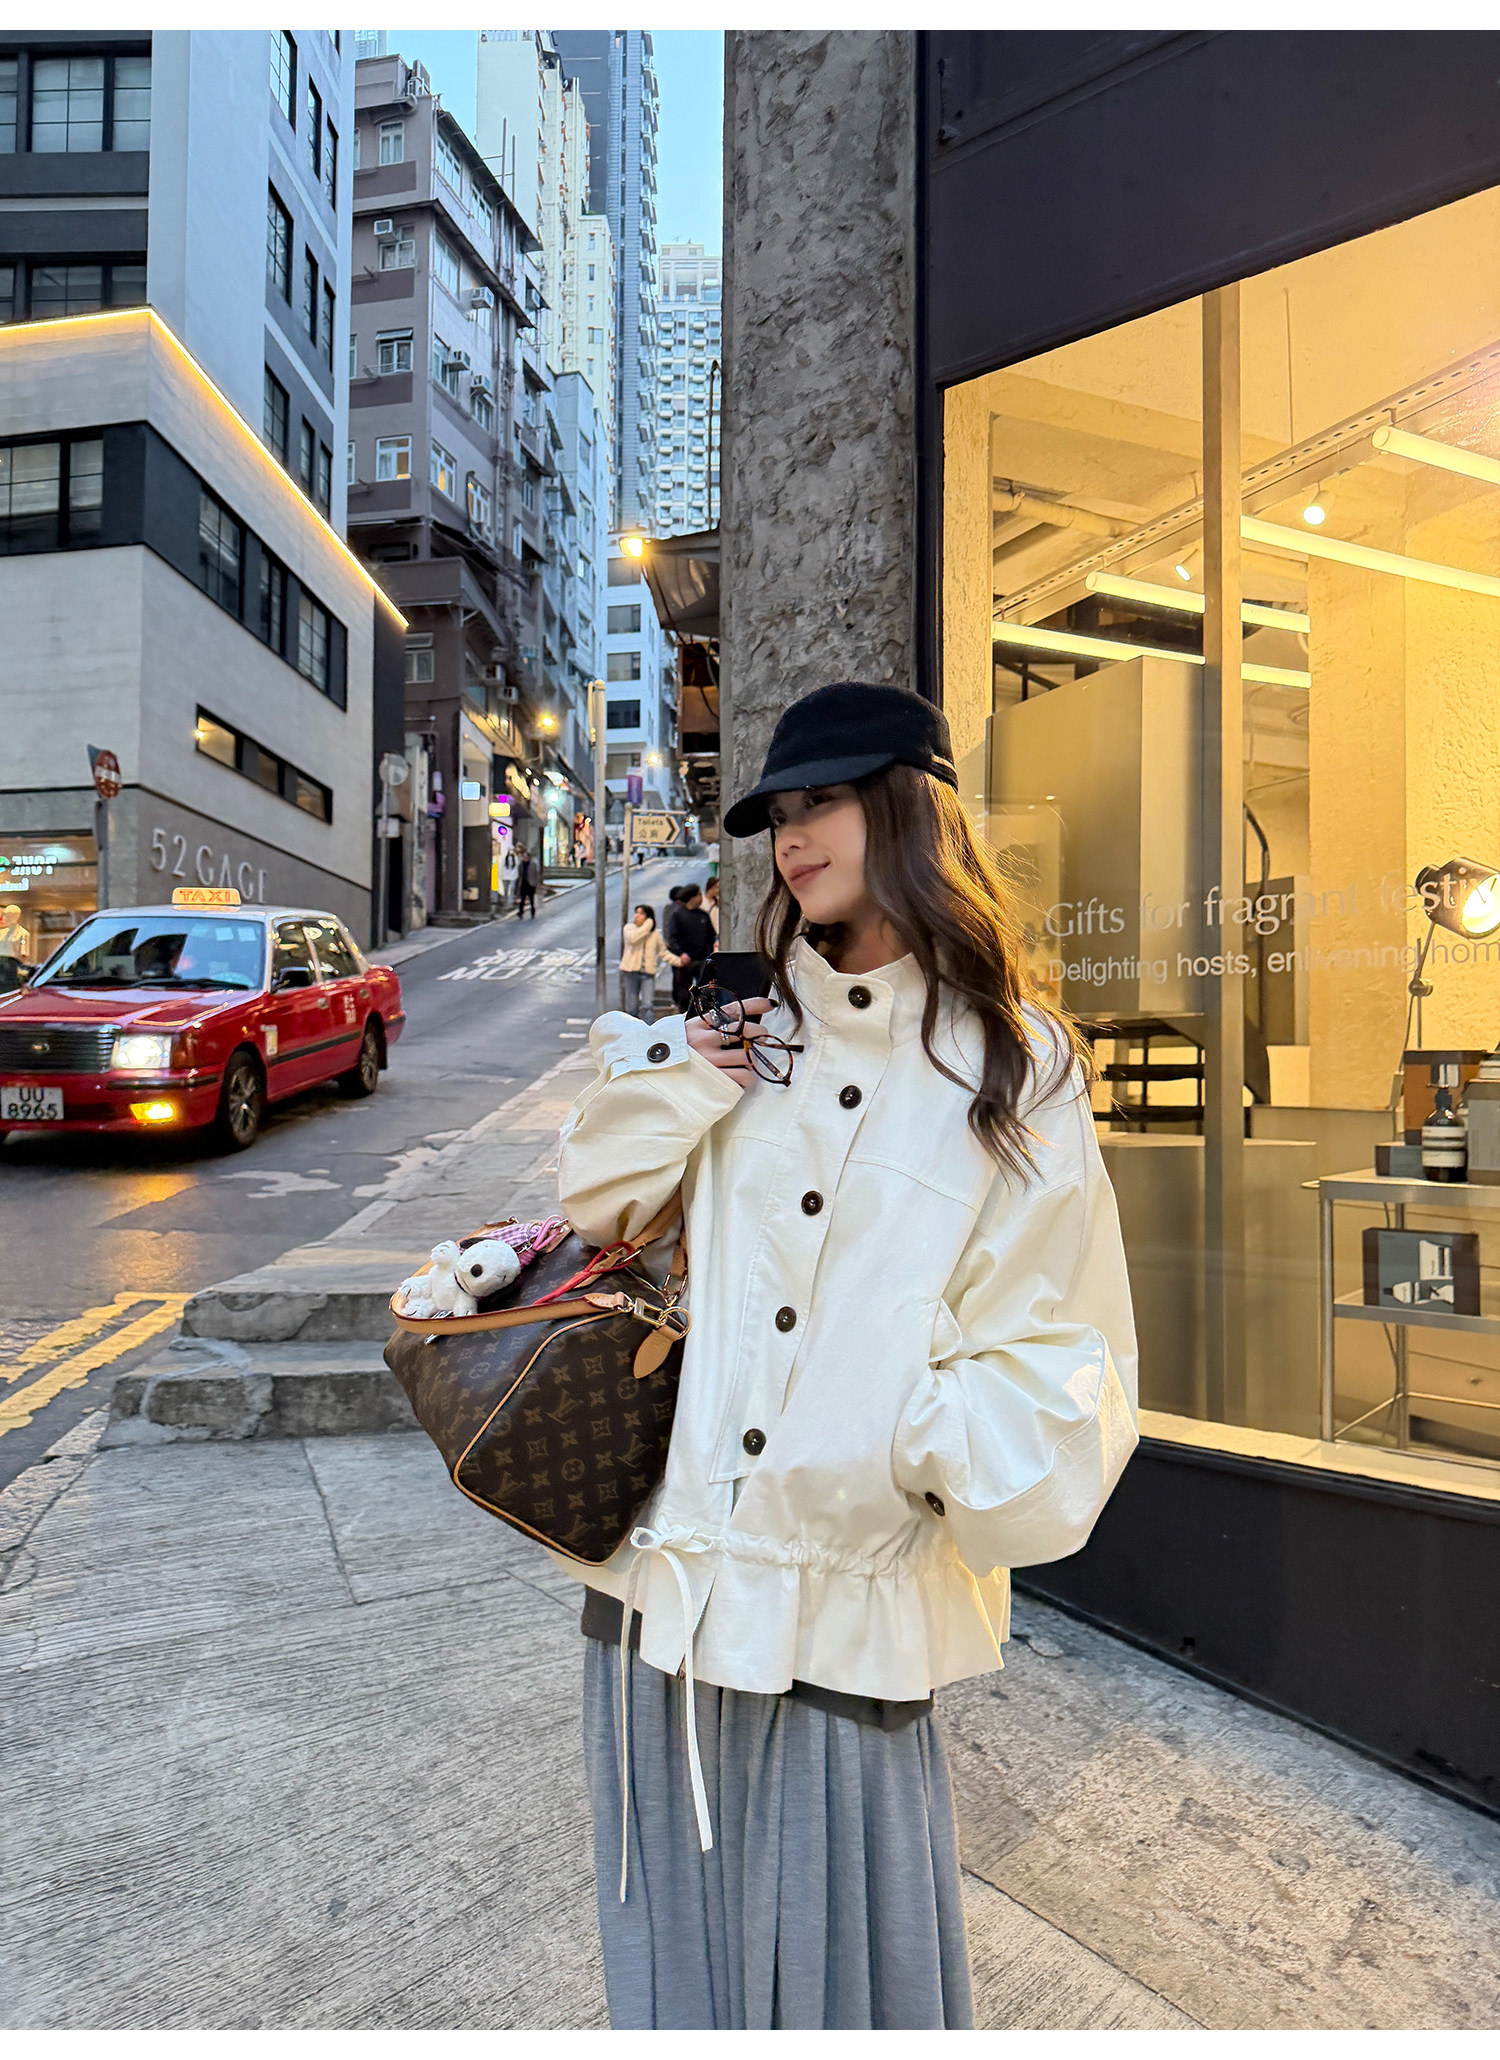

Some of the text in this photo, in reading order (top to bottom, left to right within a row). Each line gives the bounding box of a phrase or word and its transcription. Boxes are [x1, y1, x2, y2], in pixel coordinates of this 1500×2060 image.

[151, 827, 187, 877] 52
[178, 890, 232, 903] TAXI
[1044, 897, 1126, 938] Gifts
[1139, 892, 1191, 931] for
[1203, 885, 1360, 936] fragrant
[1049, 954, 1168, 987] Delighting
[1176, 951, 1258, 979] hosts,
[19, 1087, 45, 1103] UU
[8, 1103, 58, 1118] 8965
